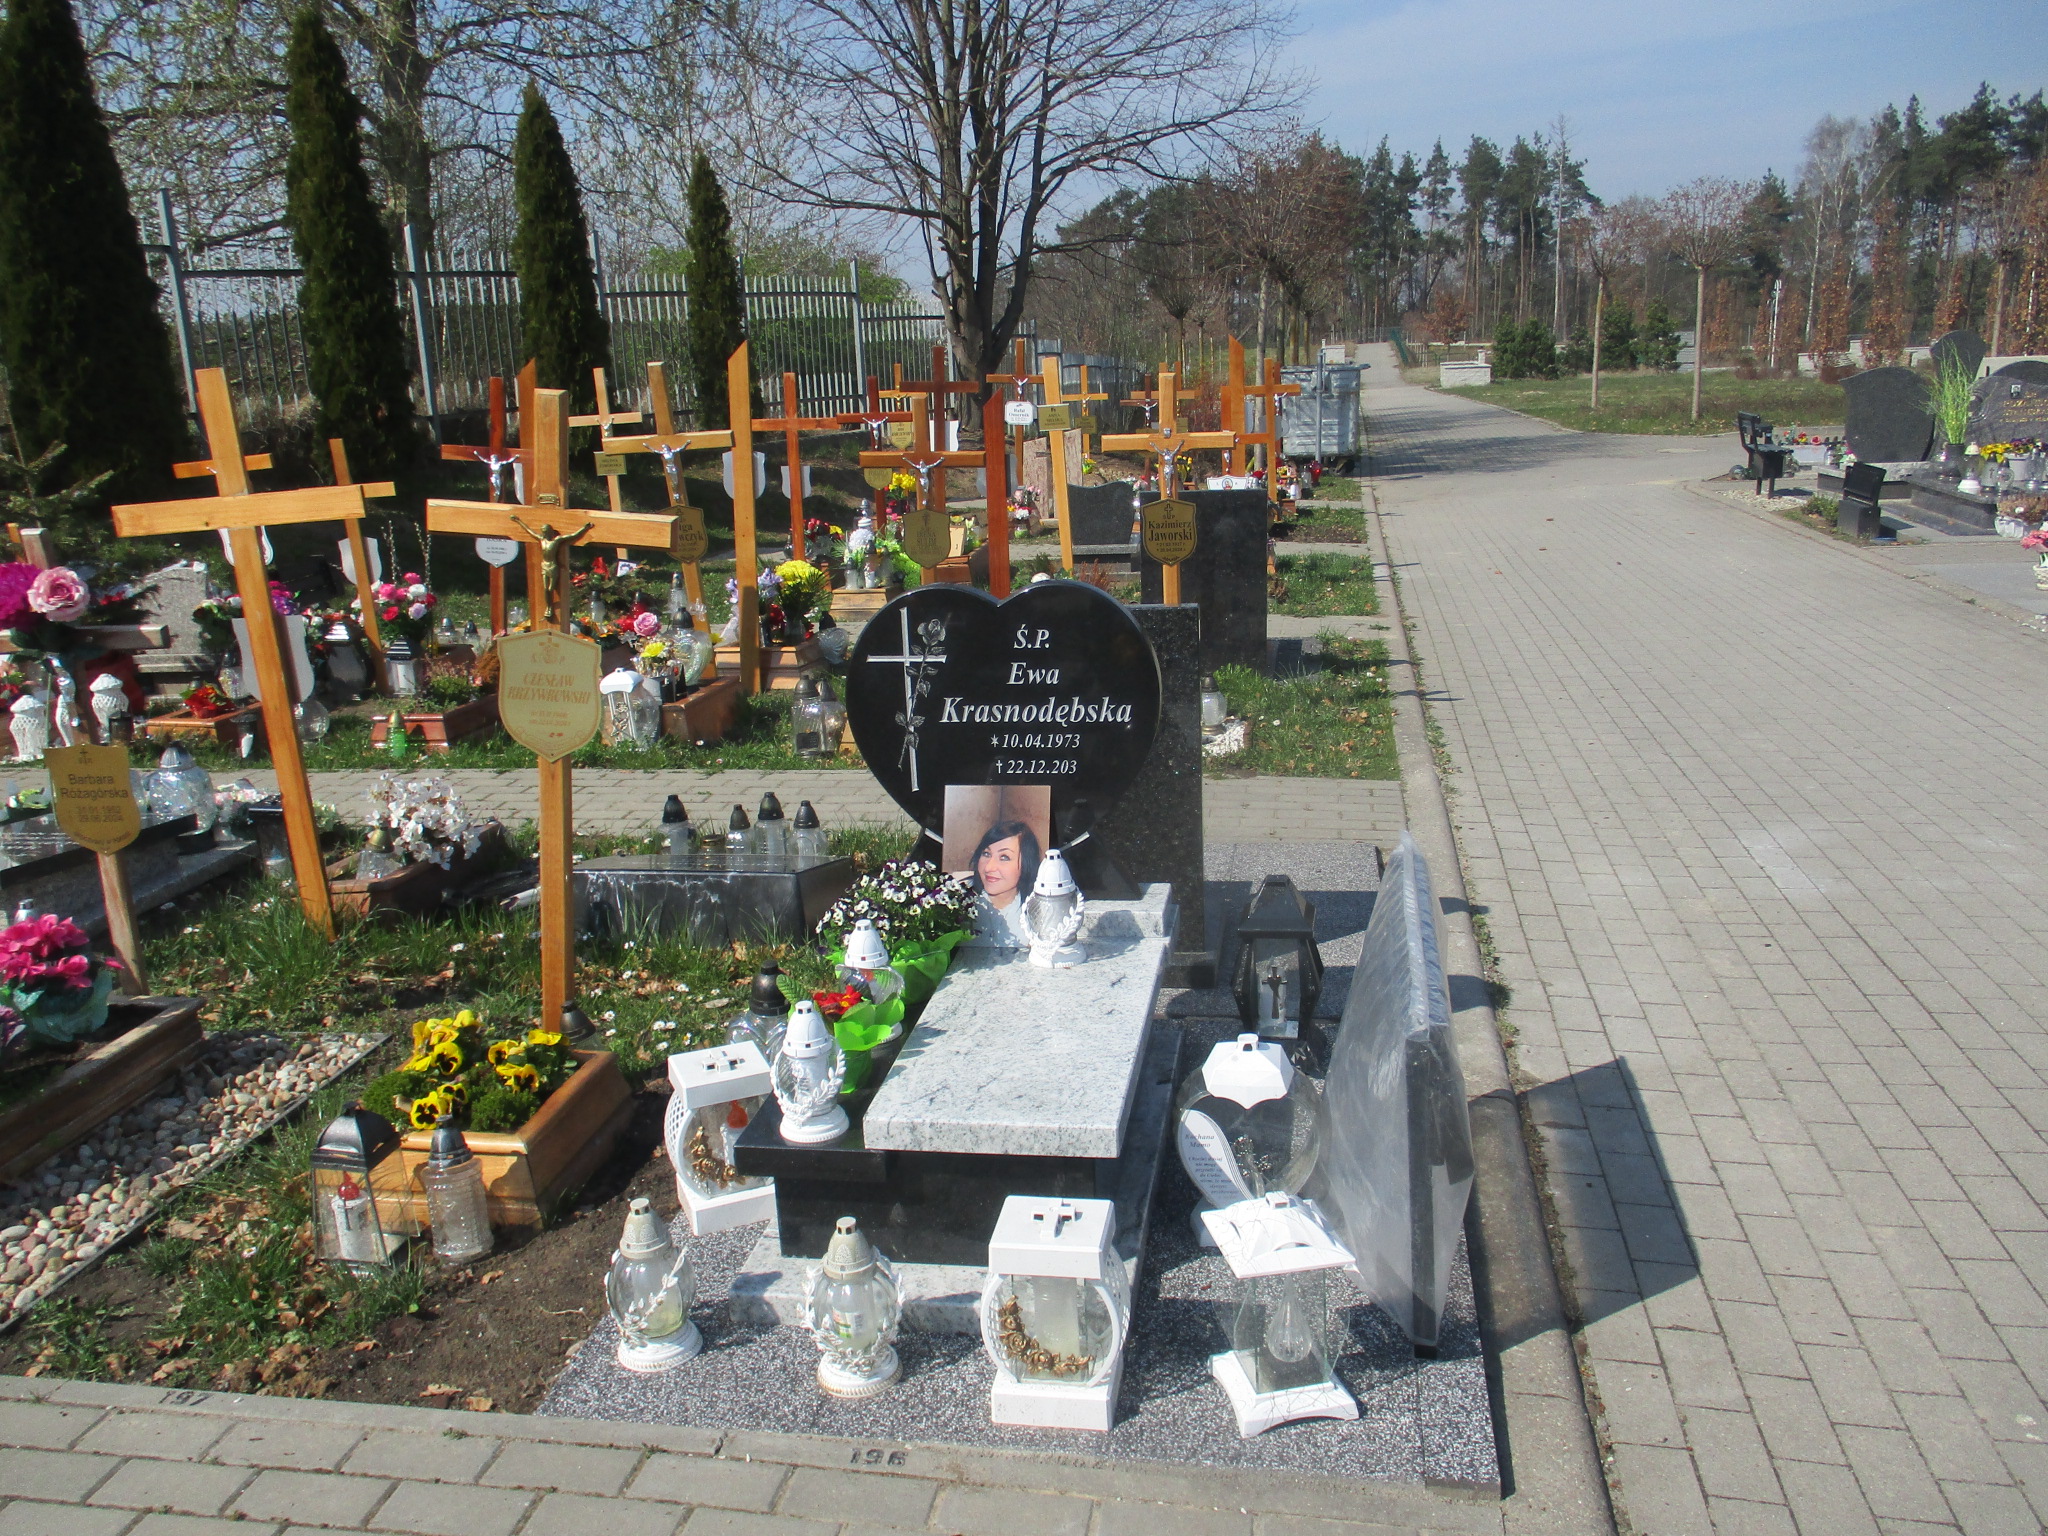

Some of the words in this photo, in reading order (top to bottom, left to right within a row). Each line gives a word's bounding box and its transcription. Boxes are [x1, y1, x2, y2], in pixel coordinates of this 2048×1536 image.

[1148, 519, 1192, 530] Kazimierz
[1148, 528, 1193, 542] Jaworski
[522, 671, 576, 688] CZESŁAW
[1006, 662, 1060, 686] Ewa
[939, 696, 1132, 727] Krasnodębska
[67, 773, 115, 785] Barbara
[158, 1390, 214, 1406] 197
[849, 1447, 909, 1467] 196
